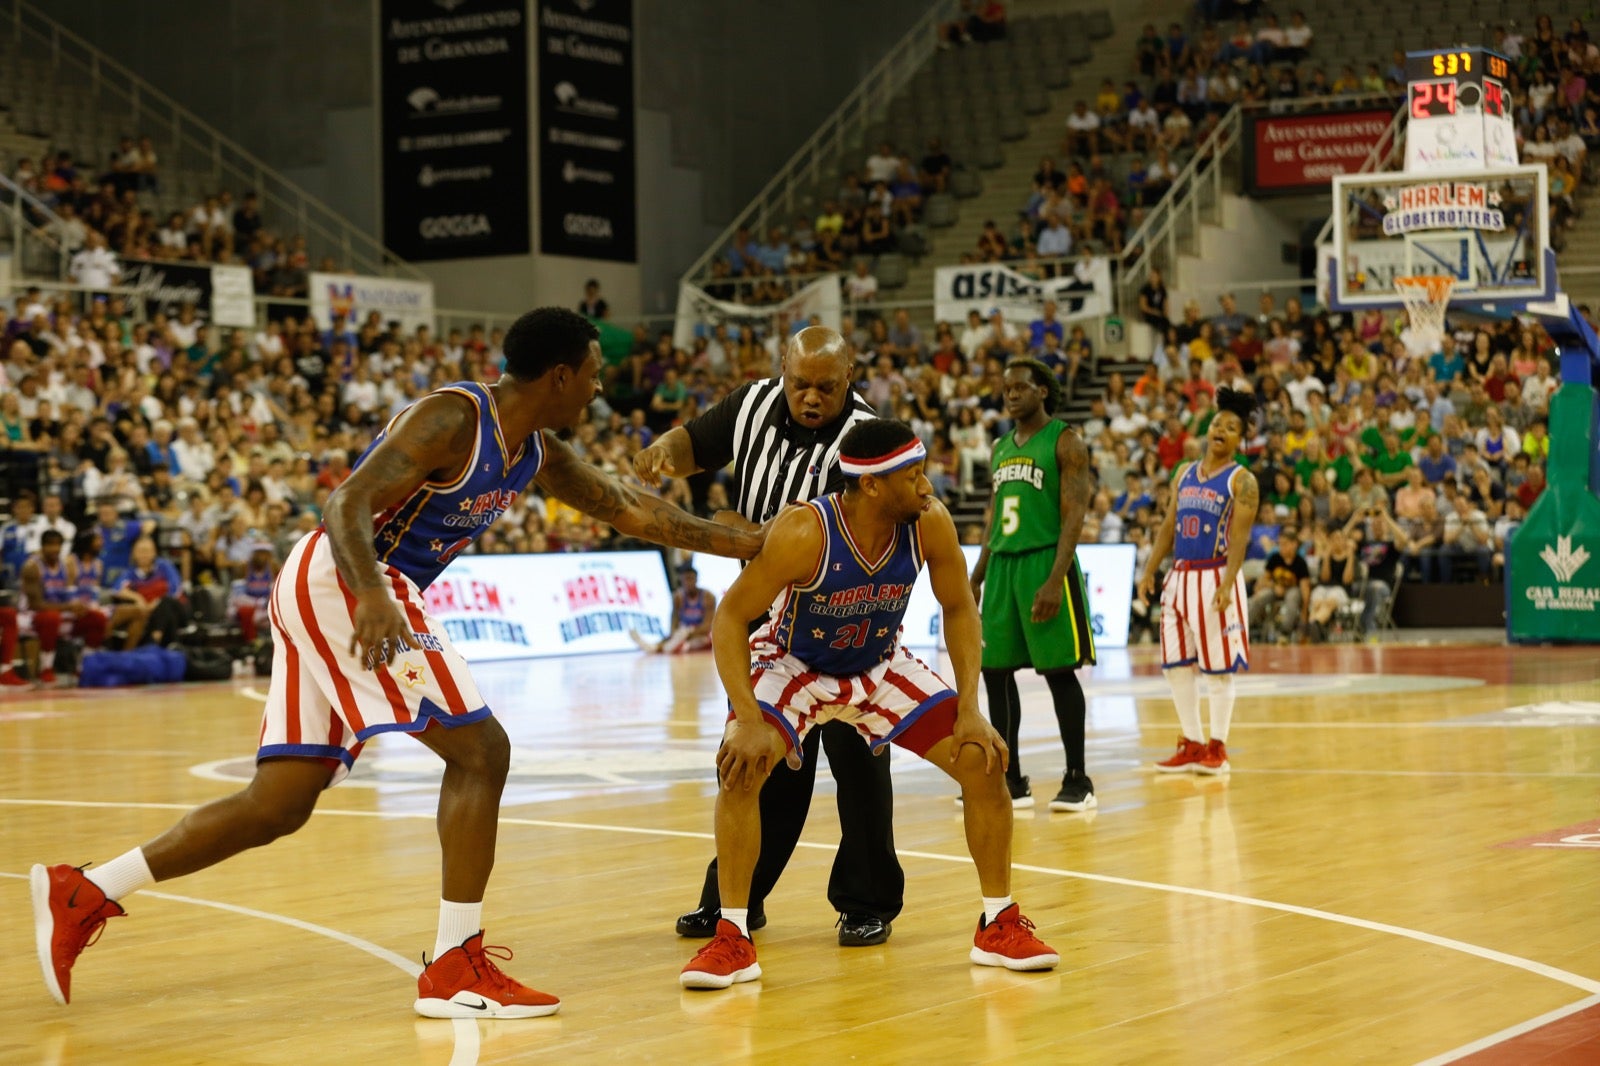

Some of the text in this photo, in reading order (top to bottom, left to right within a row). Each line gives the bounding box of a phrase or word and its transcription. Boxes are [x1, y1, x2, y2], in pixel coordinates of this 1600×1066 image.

[1412, 82, 1455, 118] 24
[1264, 121, 1385, 142] AYUNTAMIENTO
[1274, 147, 1294, 162] DE
[1401, 184, 1485, 210] HARLEM
[1385, 208, 1501, 232] GLOBETROTTERS
[1001, 495, 1020, 537] 5
[1182, 515, 1200, 539] 10
[424, 580, 503, 615] ARLEM
[564, 575, 642, 611] HARLEM
[828, 583, 904, 607] HARLEM
[829, 618, 871, 650] 21
